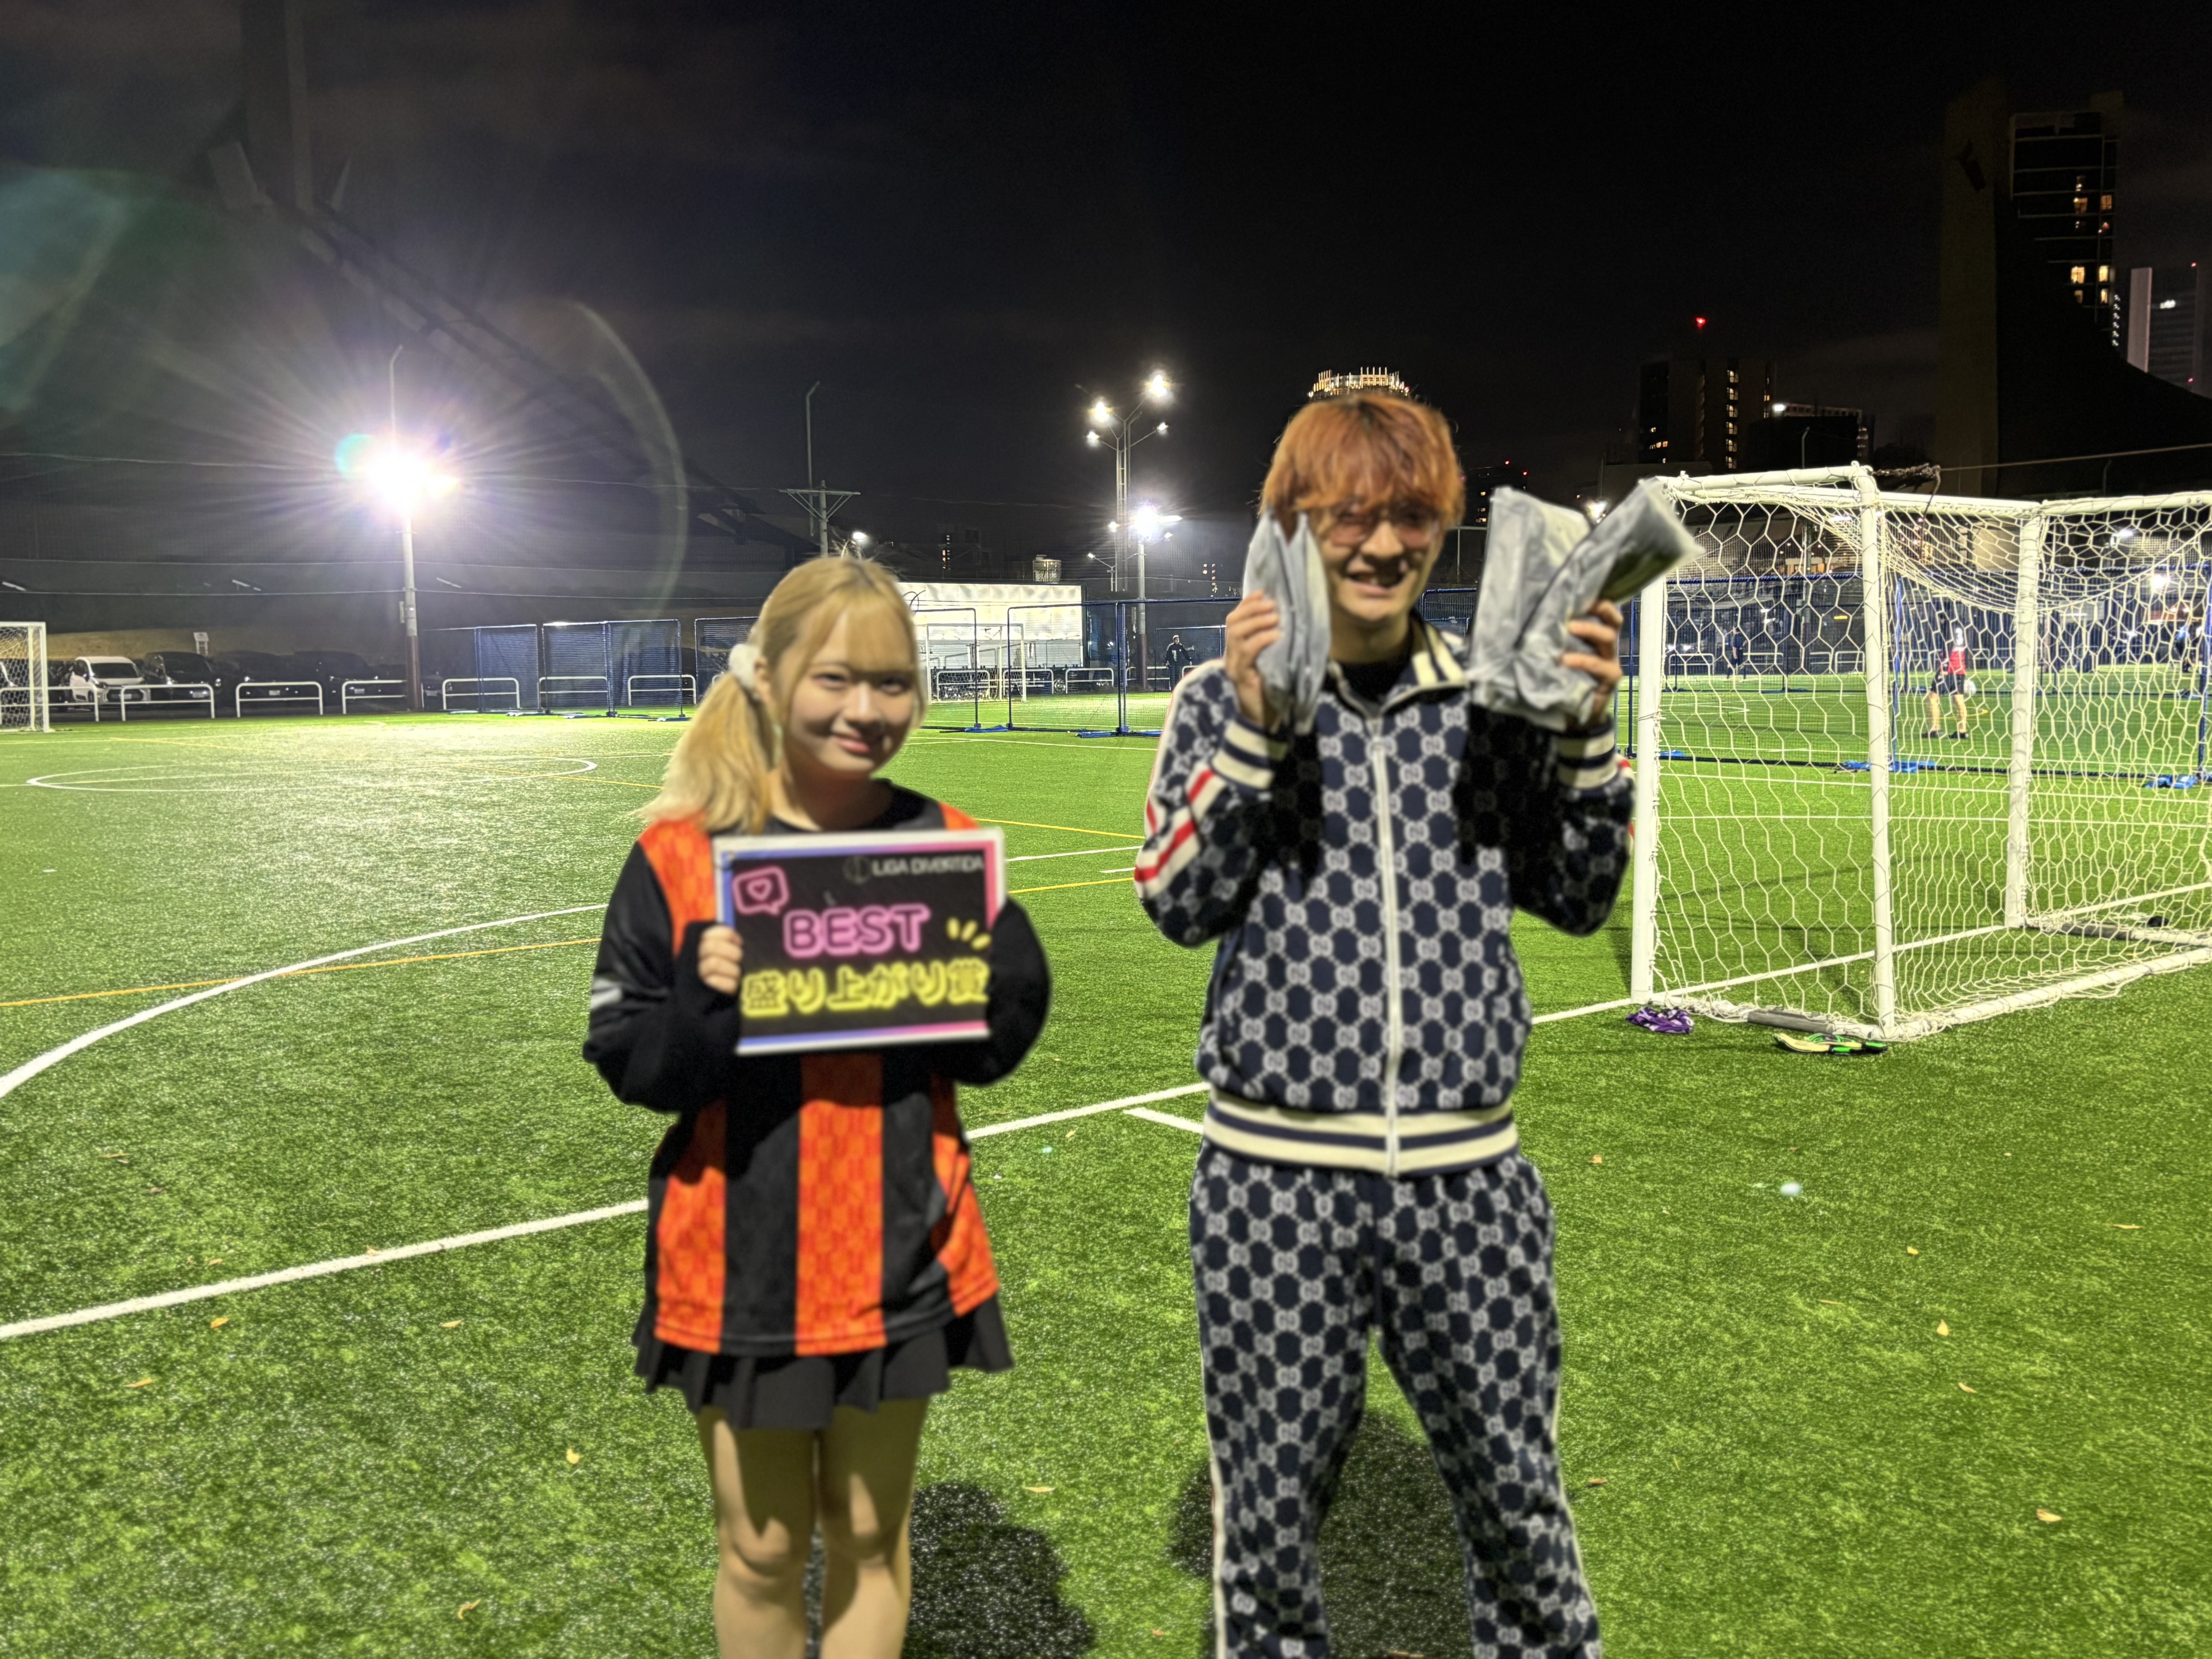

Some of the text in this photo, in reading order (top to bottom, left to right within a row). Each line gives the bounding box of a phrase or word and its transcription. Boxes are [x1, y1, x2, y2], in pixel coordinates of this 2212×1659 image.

[872, 858, 909, 876] LIGA
[784, 903, 931, 958] BEST
[742, 958, 989, 1016] 盛り上がり賞
